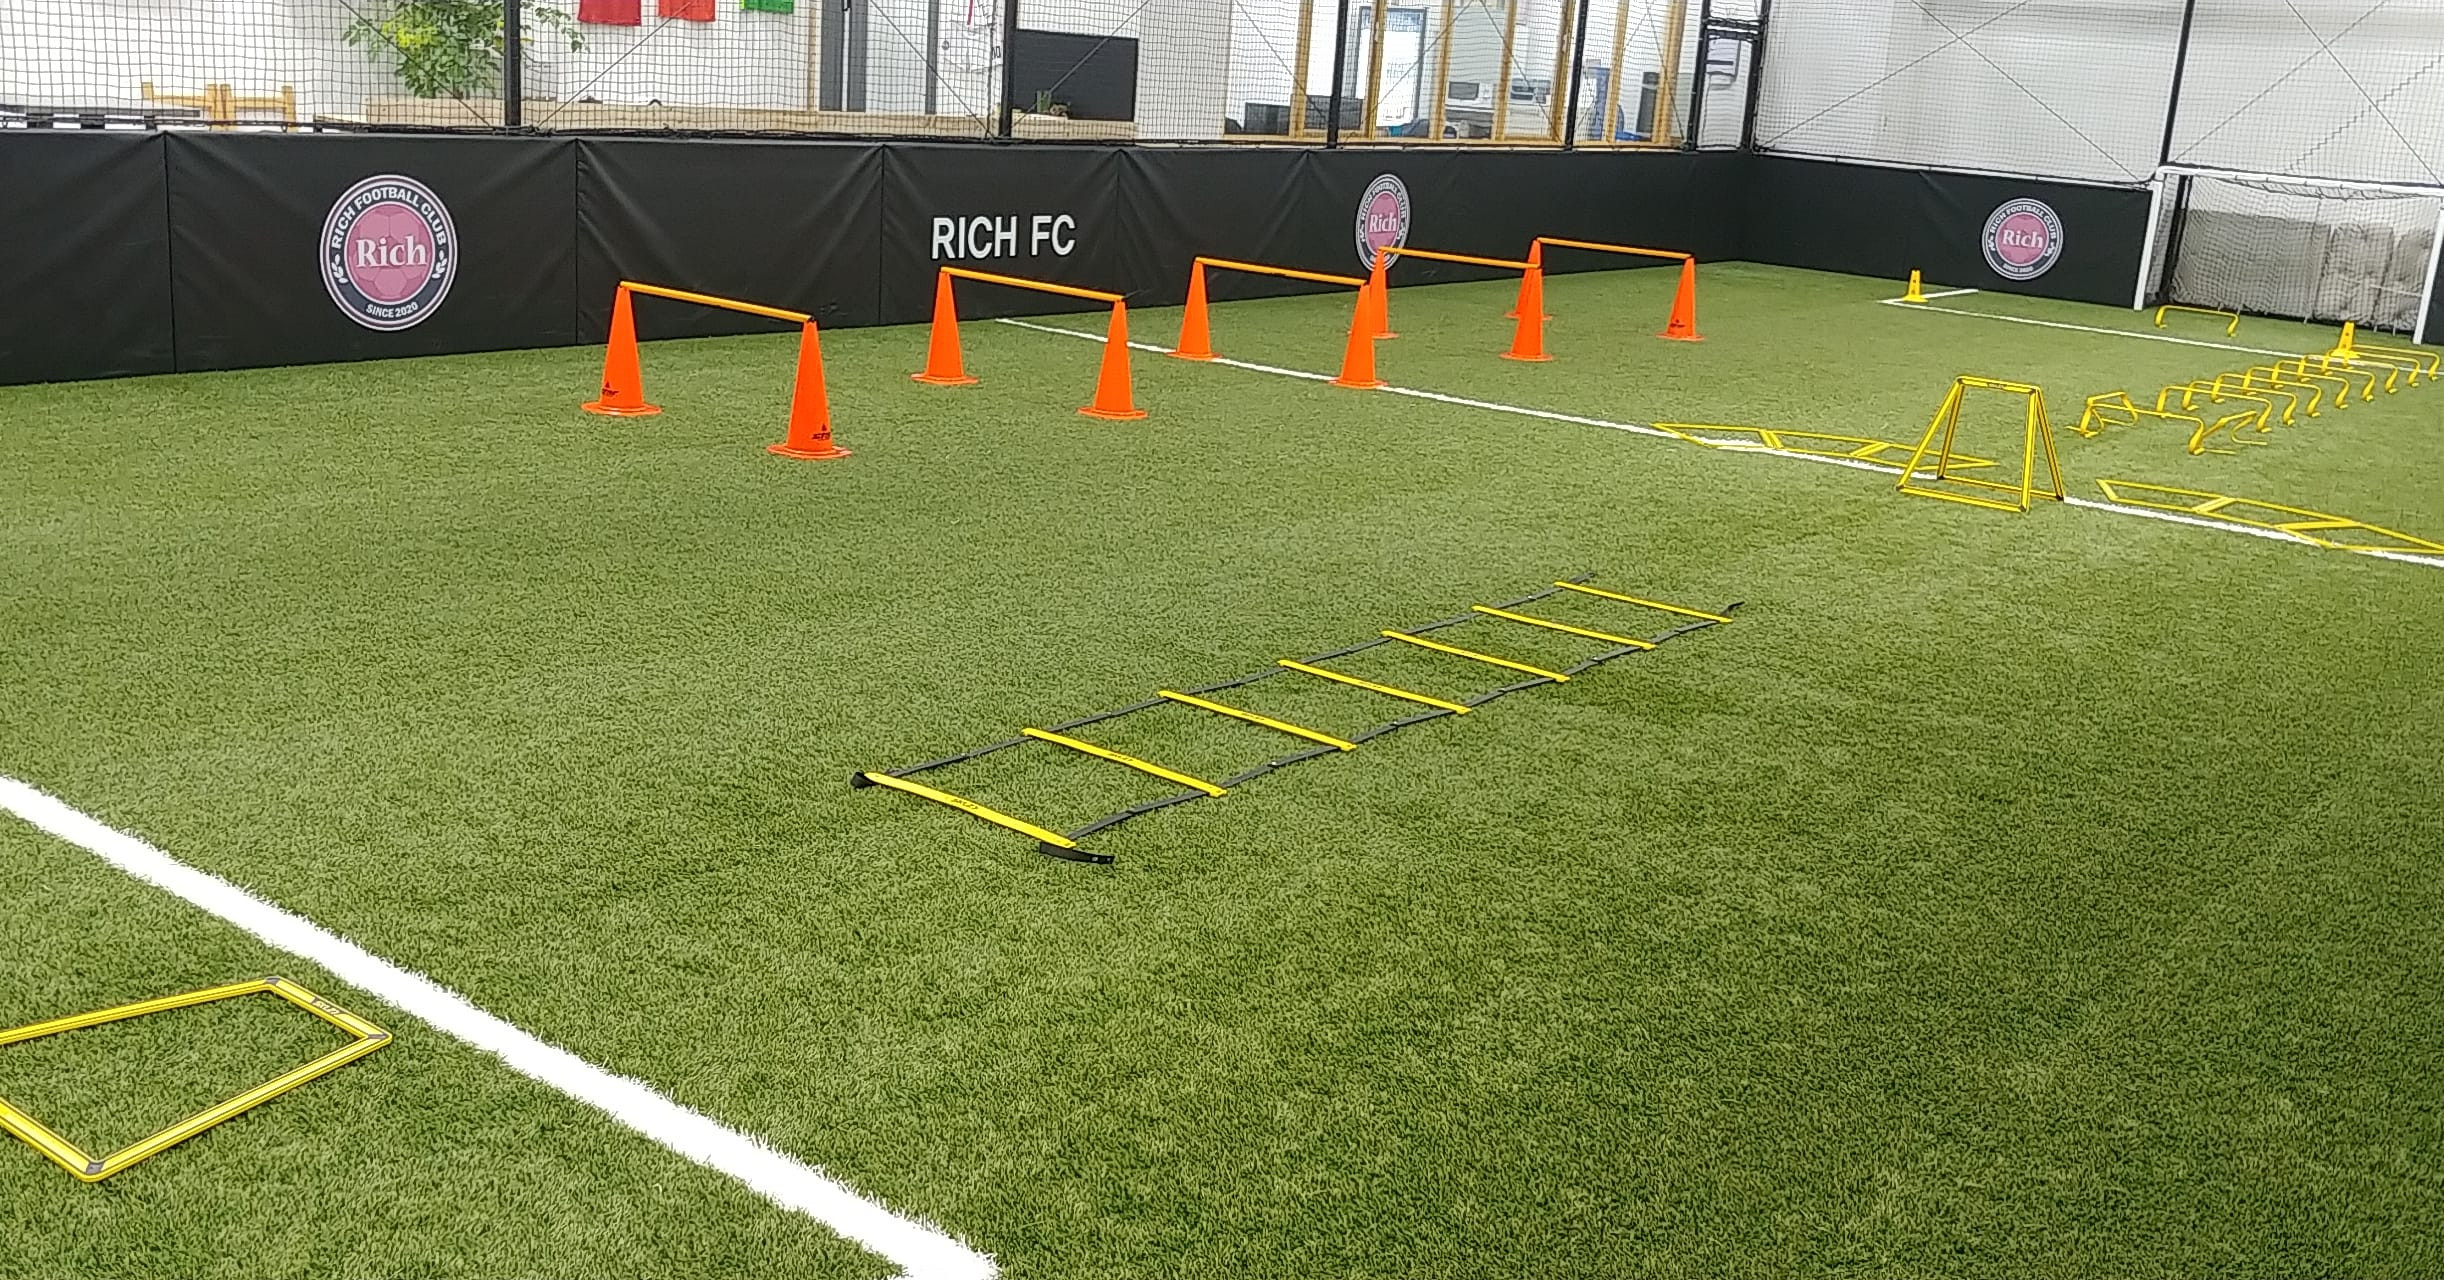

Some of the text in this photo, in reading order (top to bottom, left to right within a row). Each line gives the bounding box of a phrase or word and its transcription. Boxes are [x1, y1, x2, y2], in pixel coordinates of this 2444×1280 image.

[331, 186, 447, 249] RICH FOOTBALL CLUB
[1369, 212, 1397, 233] Rich
[931, 214, 1076, 259] RICH FC
[2002, 229, 2043, 249] Rich
[356, 234, 427, 268] Rich
[365, 301, 419, 318] SINCE 2020
